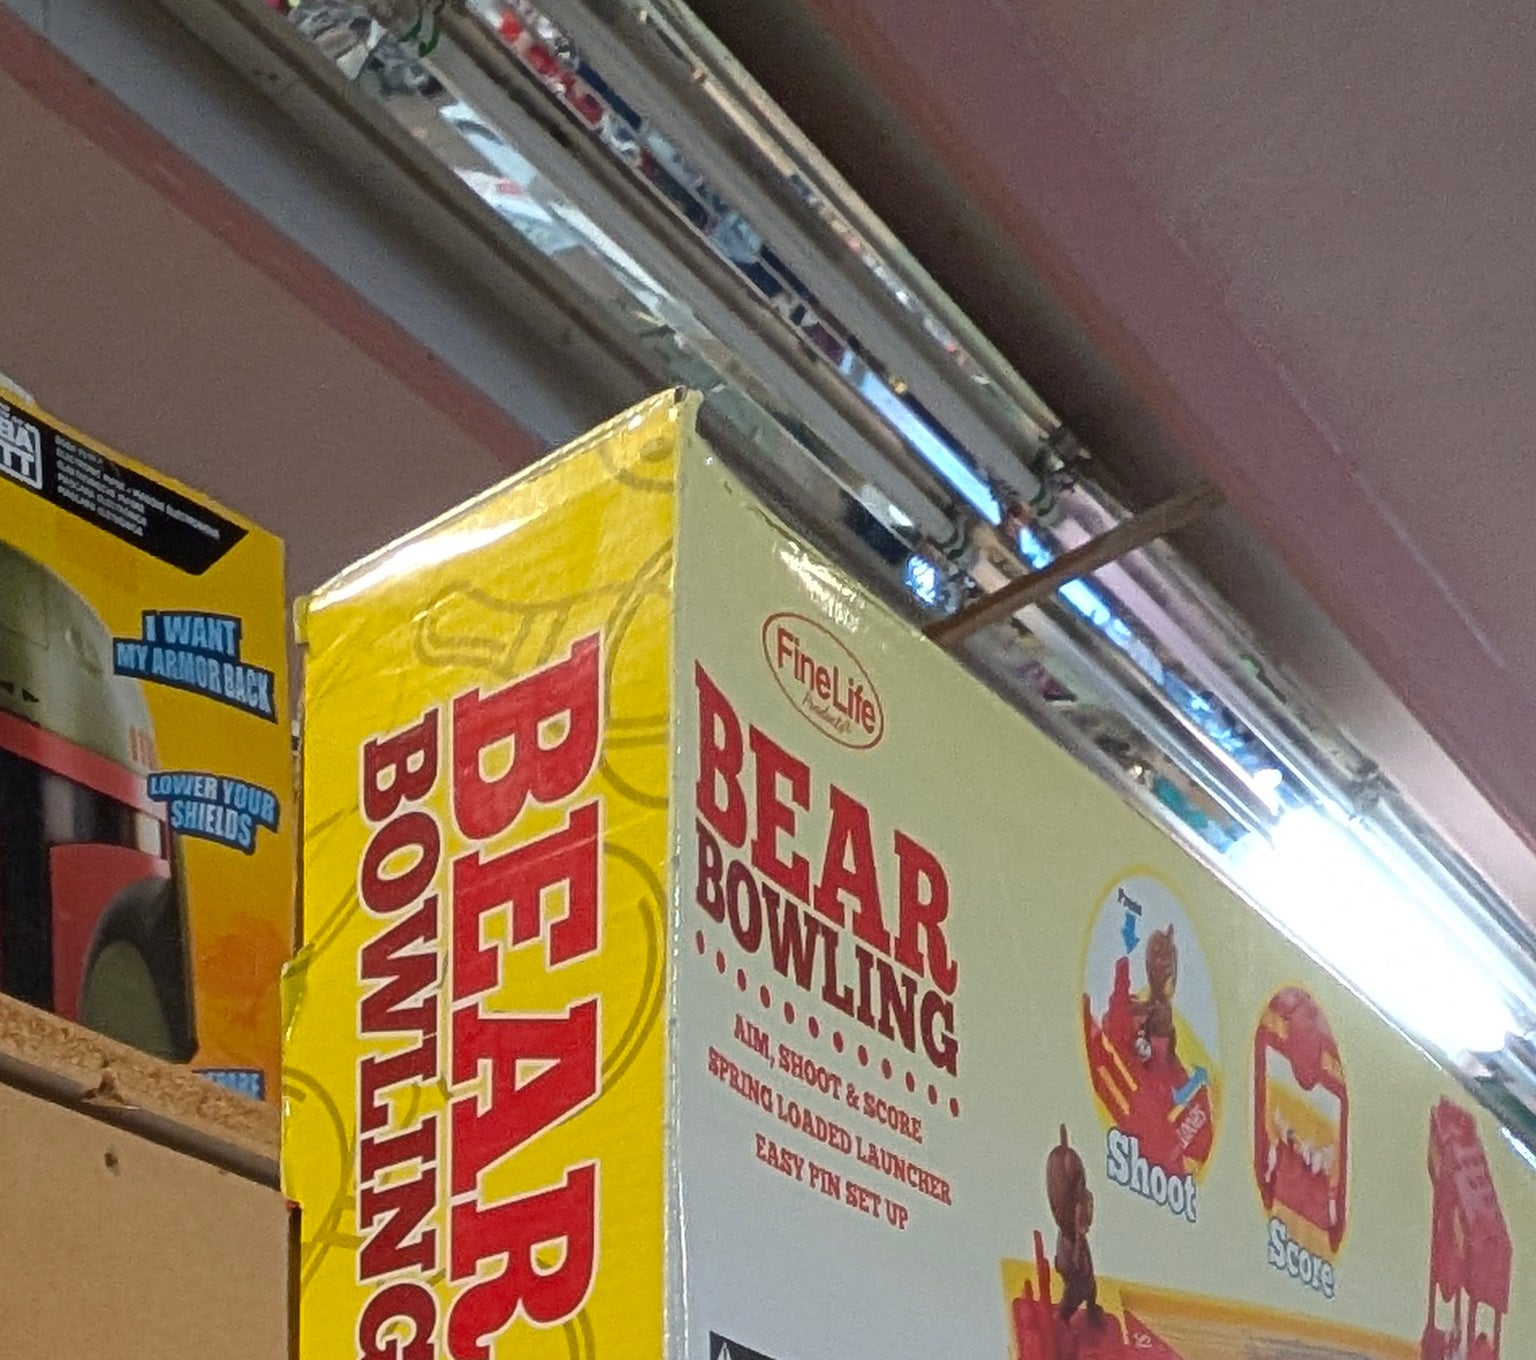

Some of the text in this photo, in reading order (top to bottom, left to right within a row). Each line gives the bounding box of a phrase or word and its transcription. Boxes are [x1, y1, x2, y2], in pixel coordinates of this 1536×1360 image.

[117, 643, 271, 714] MY ARMOR BACK
[146, 615, 238, 657] I WANT
[777, 627, 876, 734] FineLife
[151, 775, 275, 825] LOWER YOUR
[171, 799, 252, 849] SHIELDS
[695, 659, 960, 999] BEAR
[695, 816, 960, 1076] BOWLING
[708, 1046, 952, 1206] SPRING LOADED LAUNCHER
[734, 1013, 923, 1144] AIM, SHOOT & SCORE
[755, 1132, 910, 1230] EASY PIN SET UP
[1107, 1126, 1197, 1222] Shoot
[1268, 1217, 1335, 1298] Score
